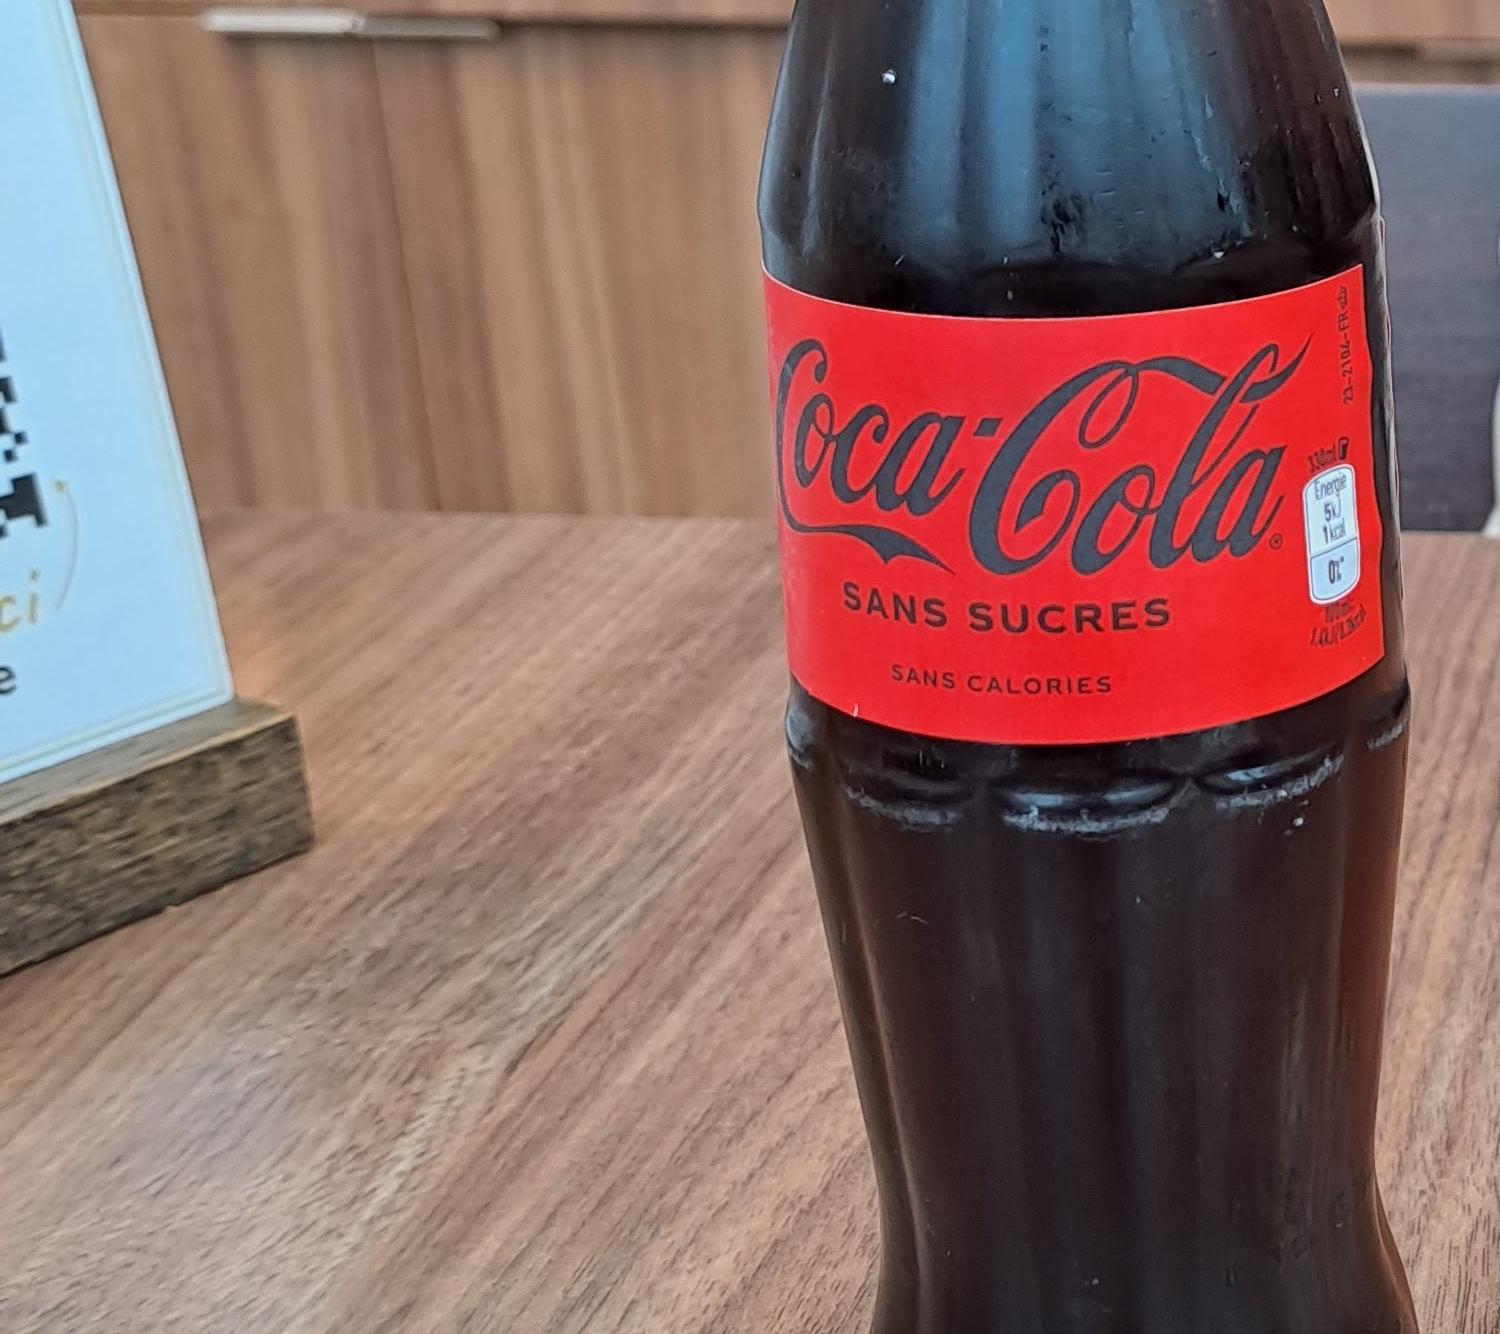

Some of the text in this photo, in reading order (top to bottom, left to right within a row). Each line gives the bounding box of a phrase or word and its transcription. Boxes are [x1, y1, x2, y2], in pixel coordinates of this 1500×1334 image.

[776, 337, 1313, 576] Coca-Cola
[843, 581, 1171, 635] SANS SUCRES
[892, 664, 1112, 695] SANS CALORIES
